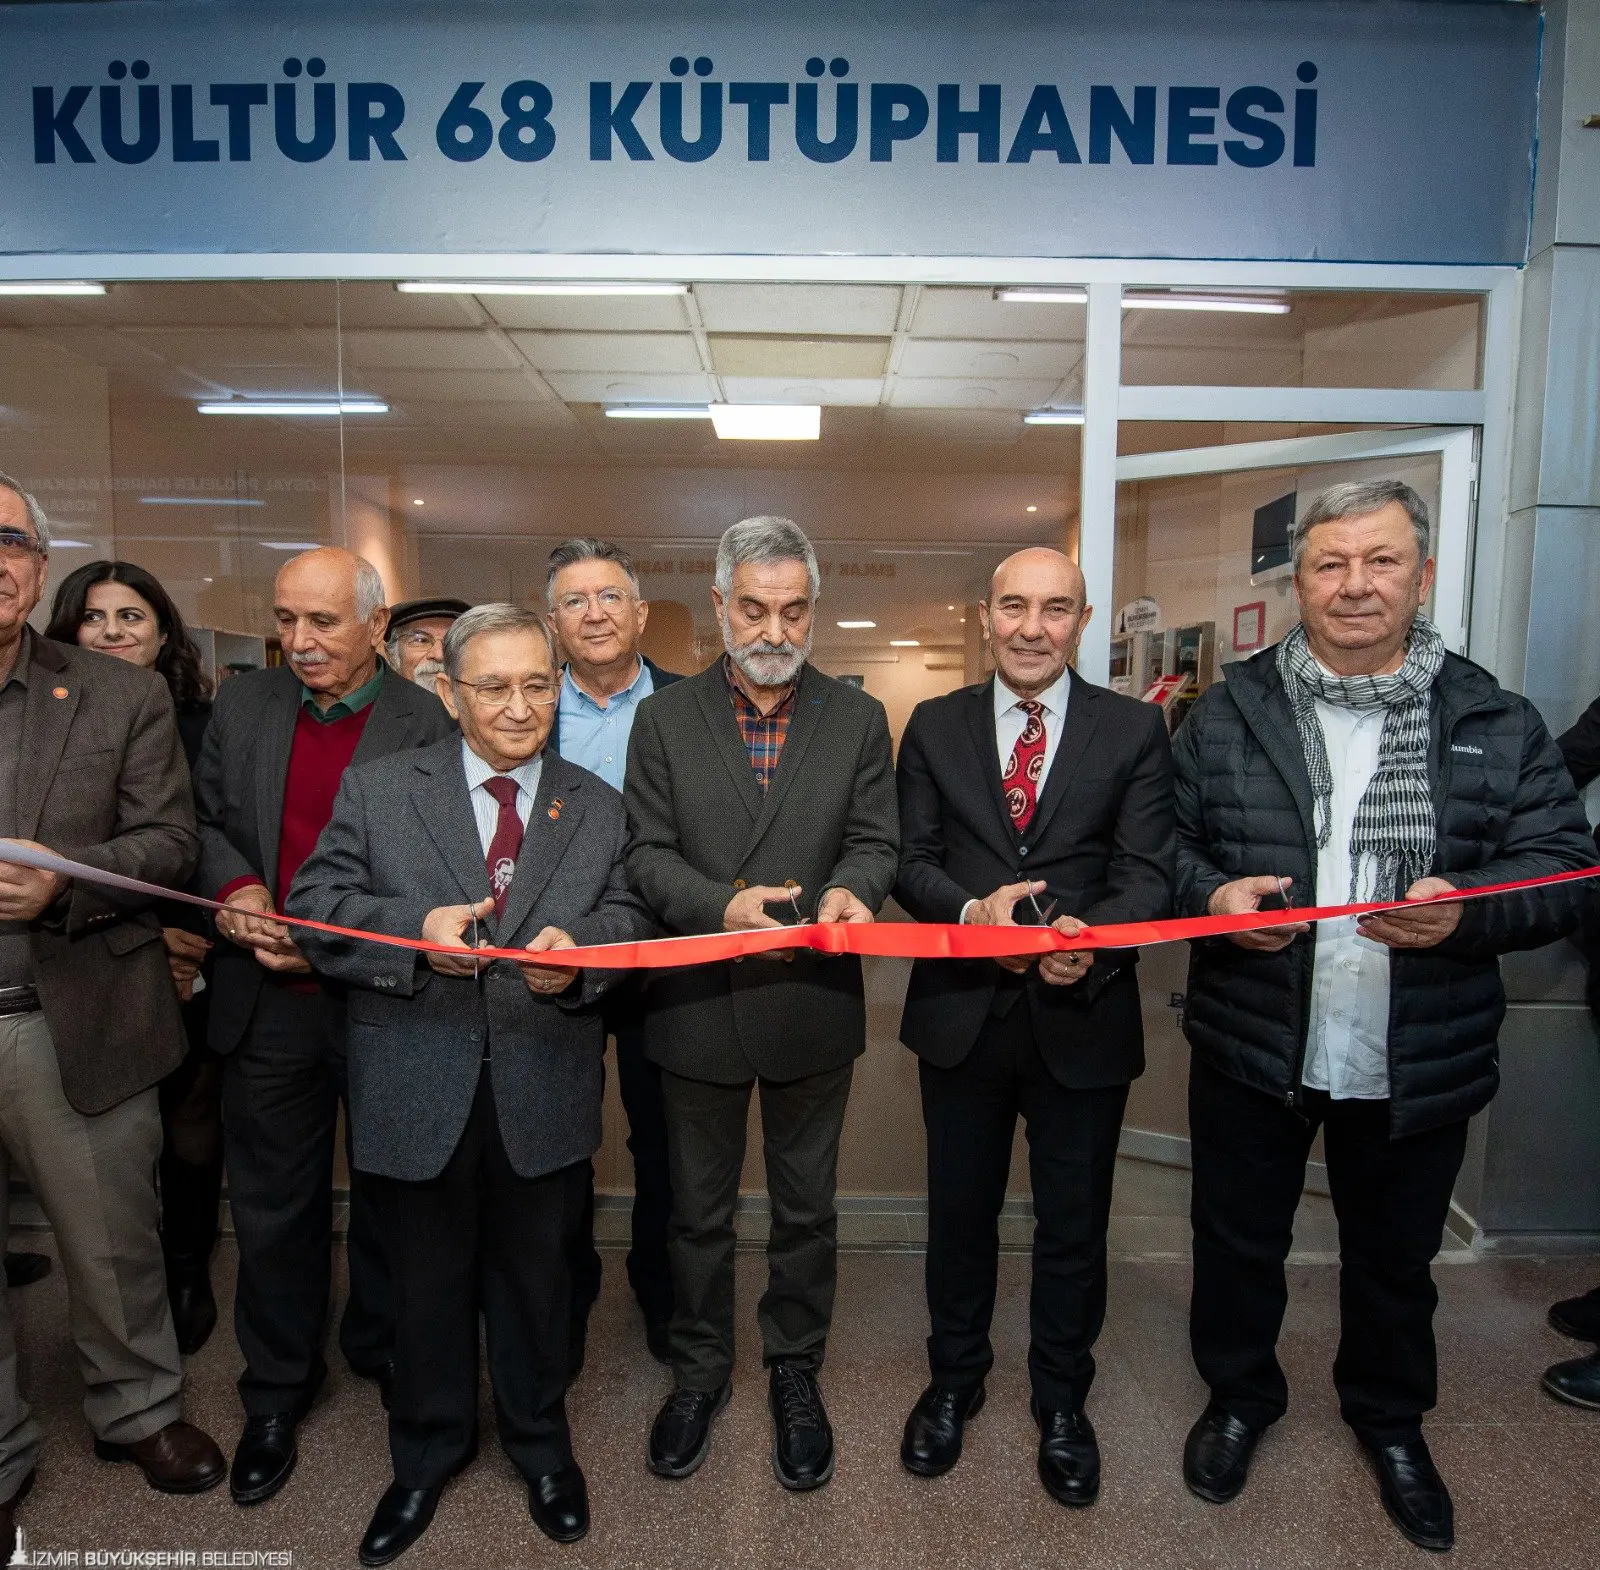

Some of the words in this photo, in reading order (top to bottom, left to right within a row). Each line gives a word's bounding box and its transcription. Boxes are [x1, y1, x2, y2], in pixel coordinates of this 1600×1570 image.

[32, 56, 408, 164] KÜLTÜR
[435, 79, 556, 163] 68
[589, 56, 1320, 169] KÜTÜPHANESİ
[1450, 744, 1483, 755] lumbia
